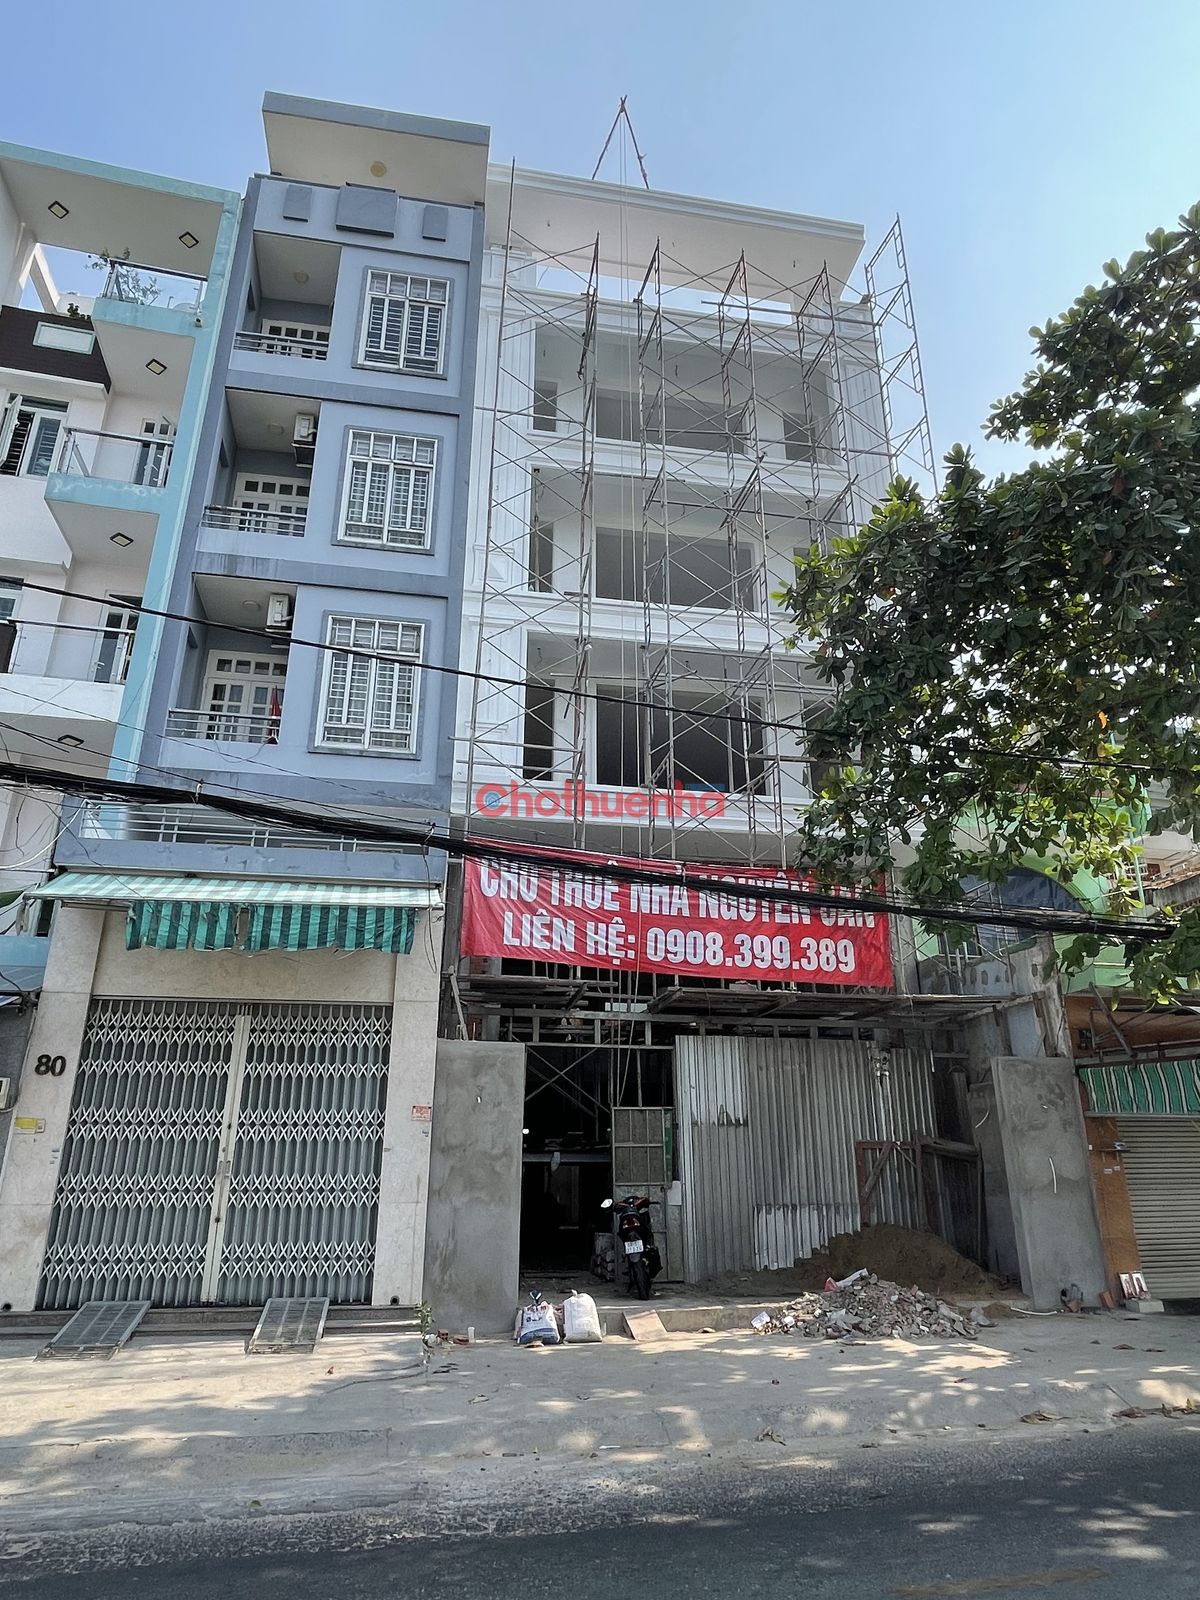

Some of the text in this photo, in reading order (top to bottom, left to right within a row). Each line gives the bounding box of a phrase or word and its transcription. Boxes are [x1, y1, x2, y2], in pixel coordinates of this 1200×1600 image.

[480, 856, 539, 902] CHO
[503, 908, 856, 973] LIÊN HỆ: 0908.399.389
[35, 1054, 67, 1077] 80
